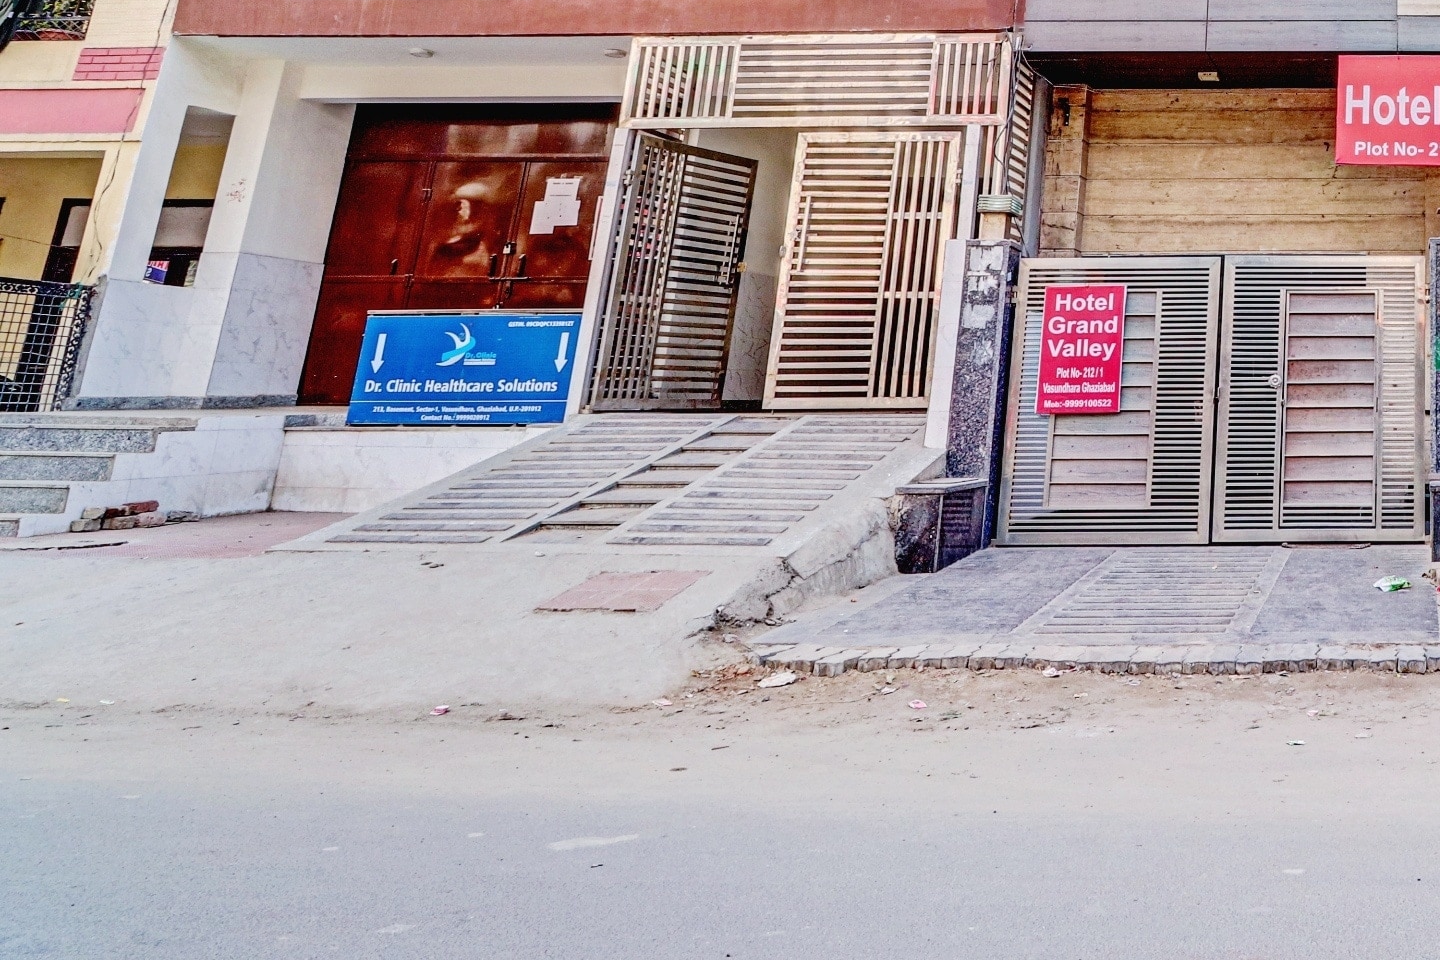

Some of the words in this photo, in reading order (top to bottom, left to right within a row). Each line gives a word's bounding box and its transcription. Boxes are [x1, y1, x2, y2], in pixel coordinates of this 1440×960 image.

[1344, 84, 1440, 126] Hotel
[1354, 141, 1389, 157] Plot
[1394, 142, 1424, 157] No-
[1055, 293, 1114, 312] Hotel
[1048, 316, 1118, 335] Grand
[1047, 339, 1117, 361] Valley
[1056, 367, 1070, 379] Plot
[1071, 367, 1082, 379] No-
[1083, 367, 1095, 378] 212
[364, 380, 382, 393] Dr.
[386, 379, 422, 393] Clinic
[424, 379, 493, 393] Healthcare
[497, 379, 558, 393] Solutions
[1043, 382, 1080, 394] Vasundhara
[1081, 381, 1115, 393] Ghaziabad
